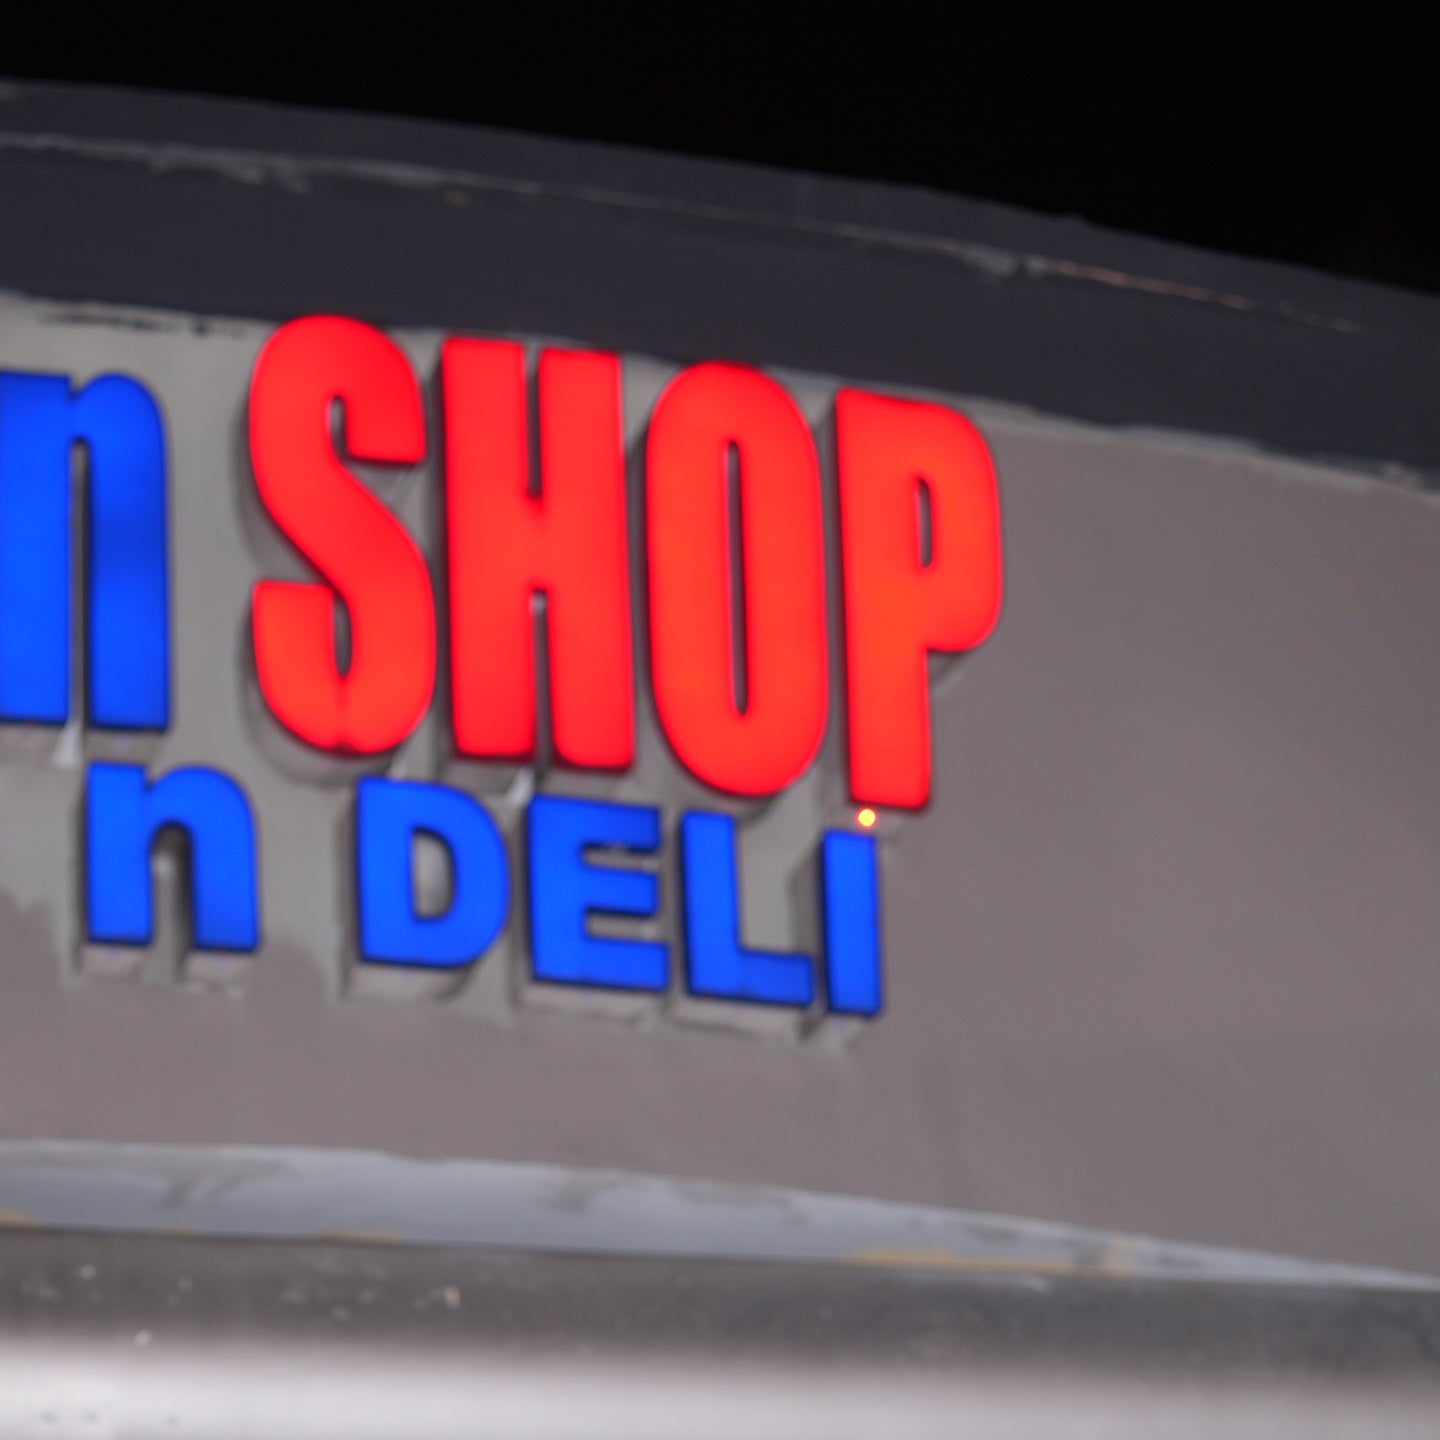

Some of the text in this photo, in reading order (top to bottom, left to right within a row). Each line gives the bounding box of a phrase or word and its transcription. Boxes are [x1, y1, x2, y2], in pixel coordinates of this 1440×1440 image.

[248, 313, 1003, 816] SHOP
[84, 762, 259, 951] n
[355, 775, 882, 1016] DELI
